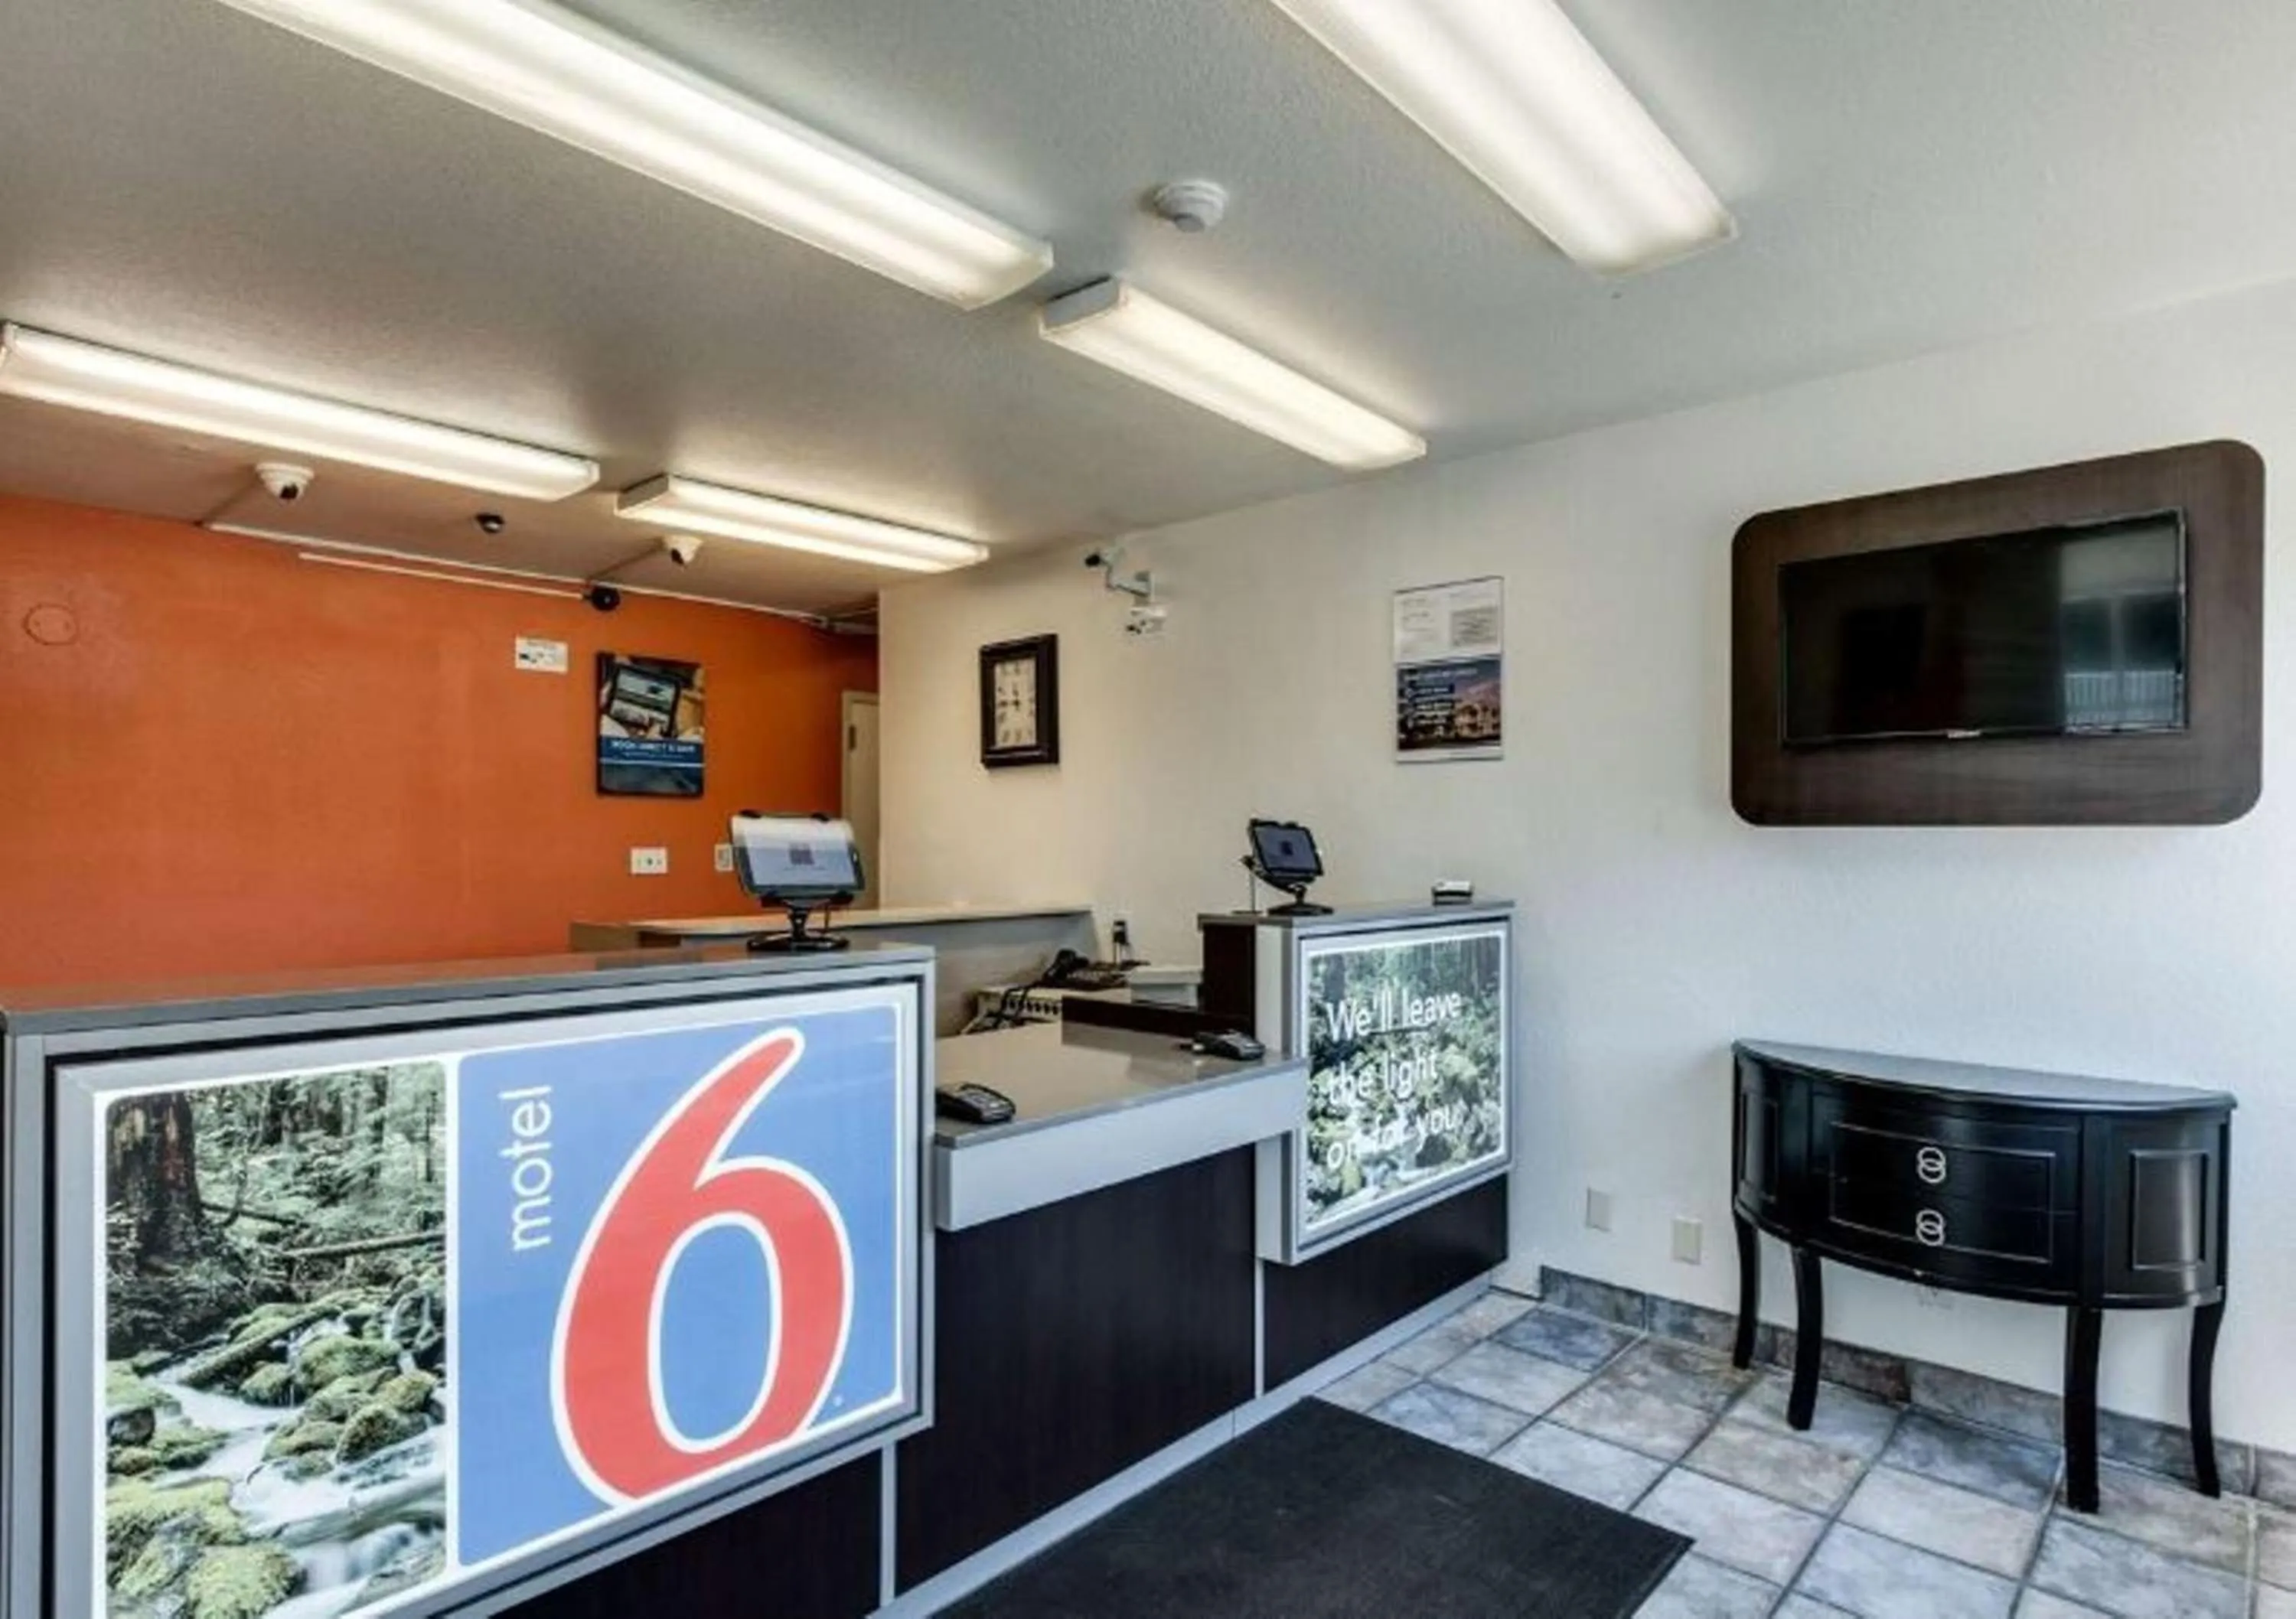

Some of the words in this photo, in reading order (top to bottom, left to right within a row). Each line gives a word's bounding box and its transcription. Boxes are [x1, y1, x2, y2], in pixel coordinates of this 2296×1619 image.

[1326, 980, 1394, 1043] We'll
[1401, 987, 1462, 1031] leave
[1383, 1043, 1438, 1099] light
[497, 1085, 554, 1253] motel
[549, 1027, 855, 1510] 6
